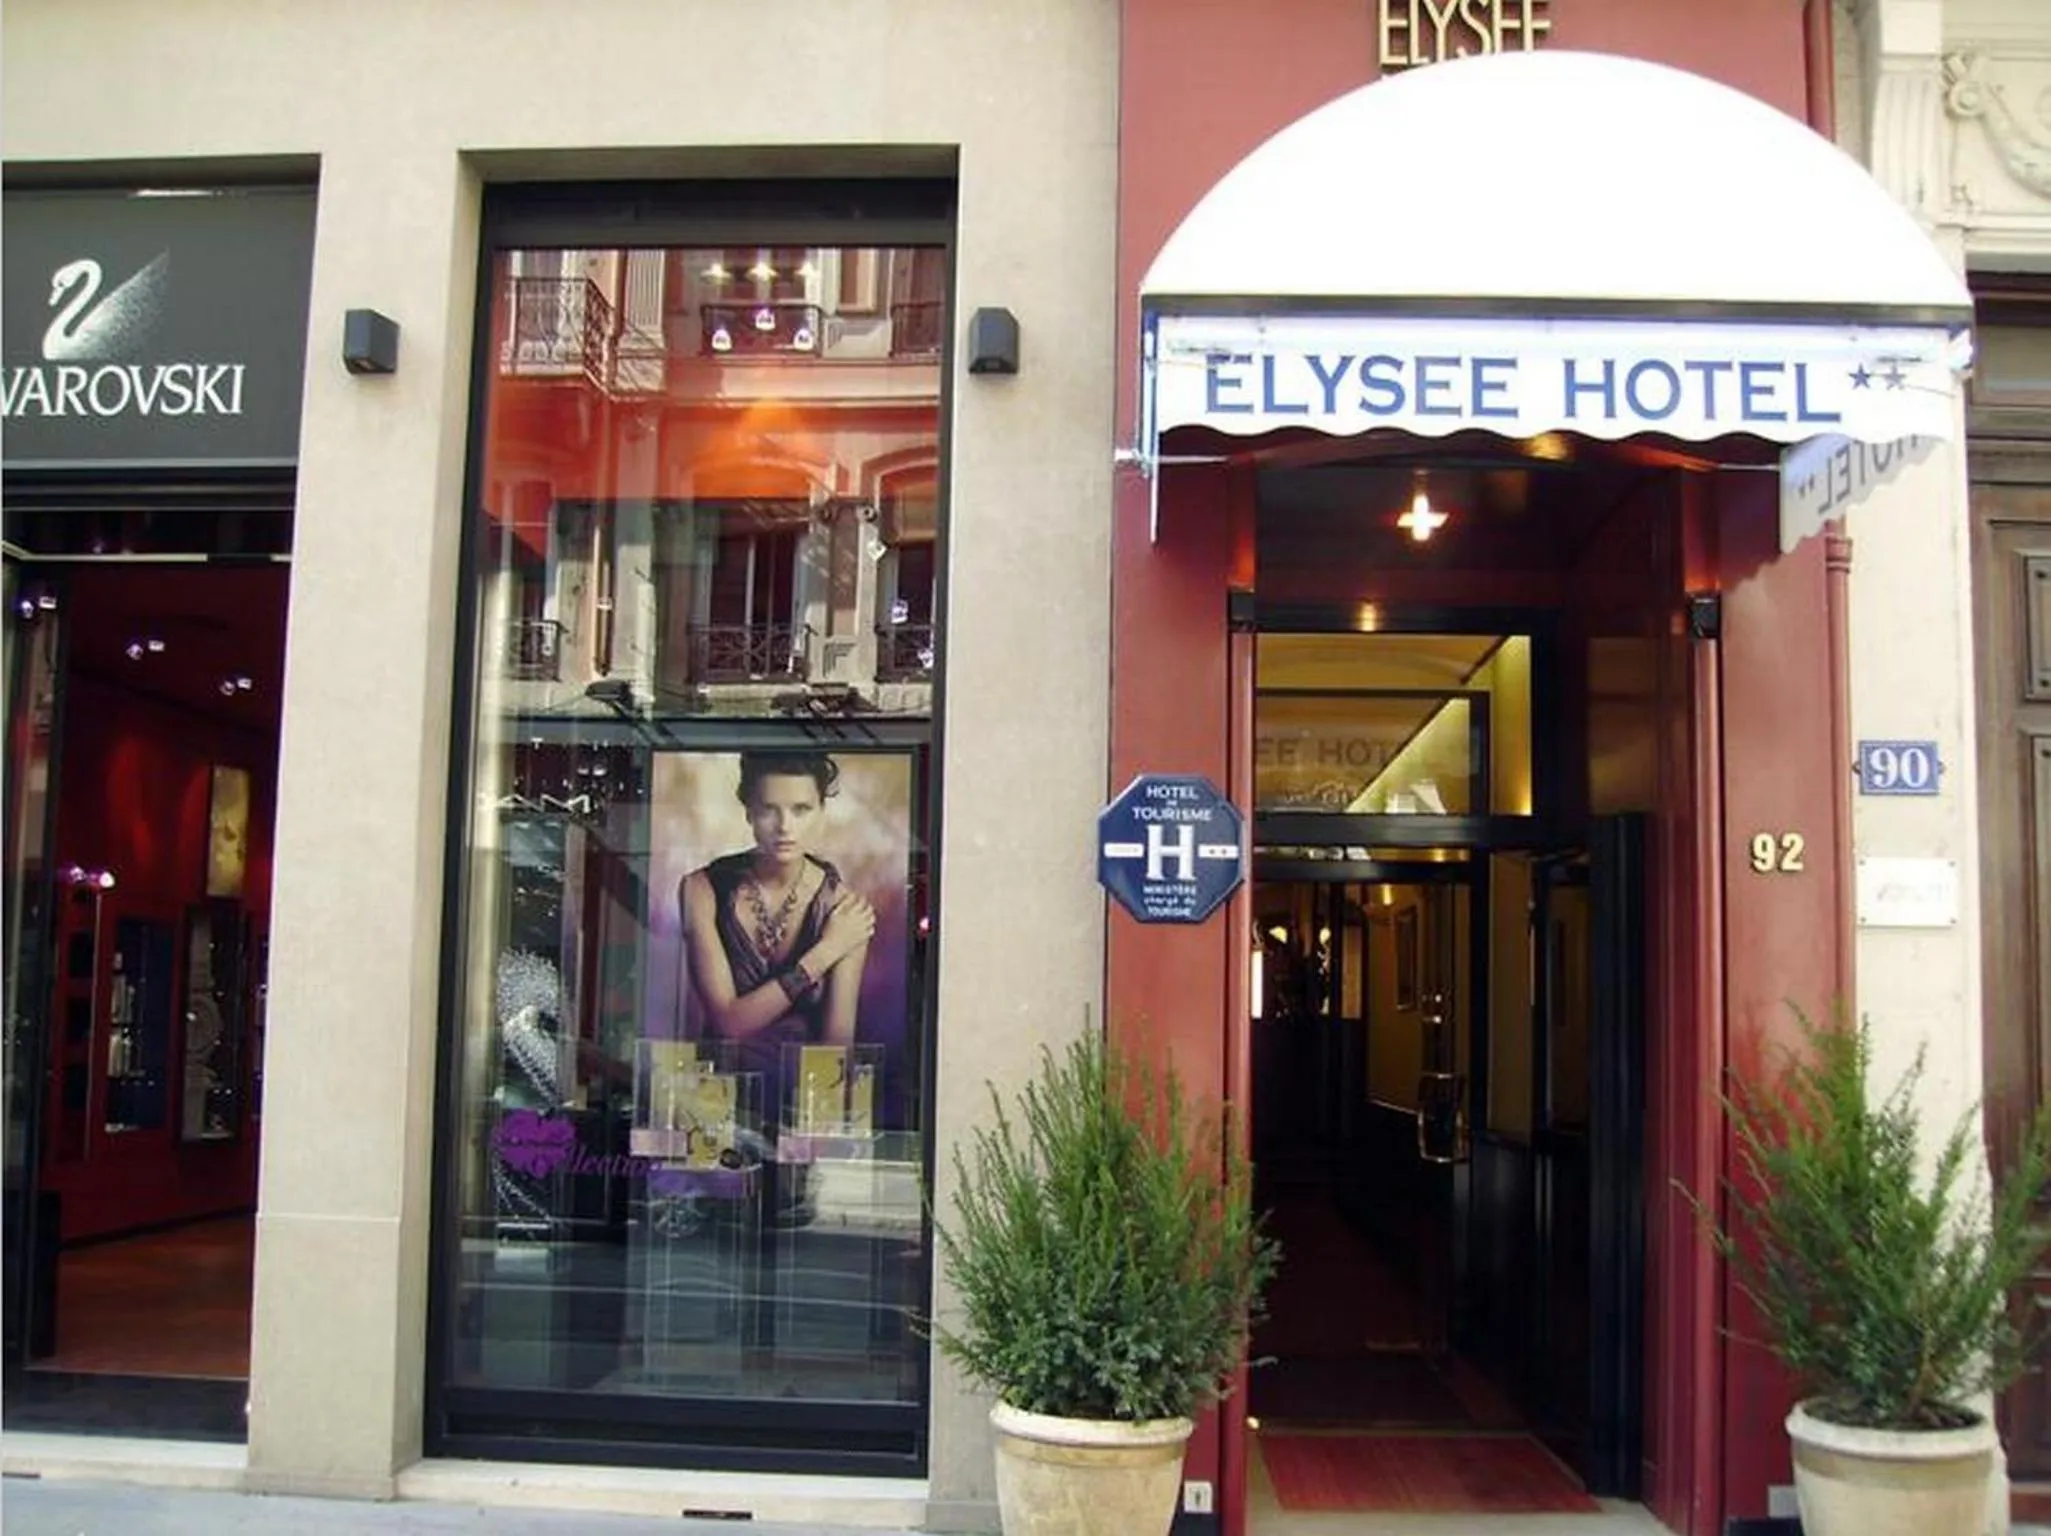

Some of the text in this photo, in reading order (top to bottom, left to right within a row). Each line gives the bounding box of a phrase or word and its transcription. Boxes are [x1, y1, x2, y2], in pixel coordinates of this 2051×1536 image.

[1205, 354, 1842, 424] ELYSEE HOTEL
[1870, 748, 1929, 788] 90
[1132, 807, 1213, 821] TOURISME
[1146, 824, 1197, 881] H
[1752, 832, 1805, 872] 92
